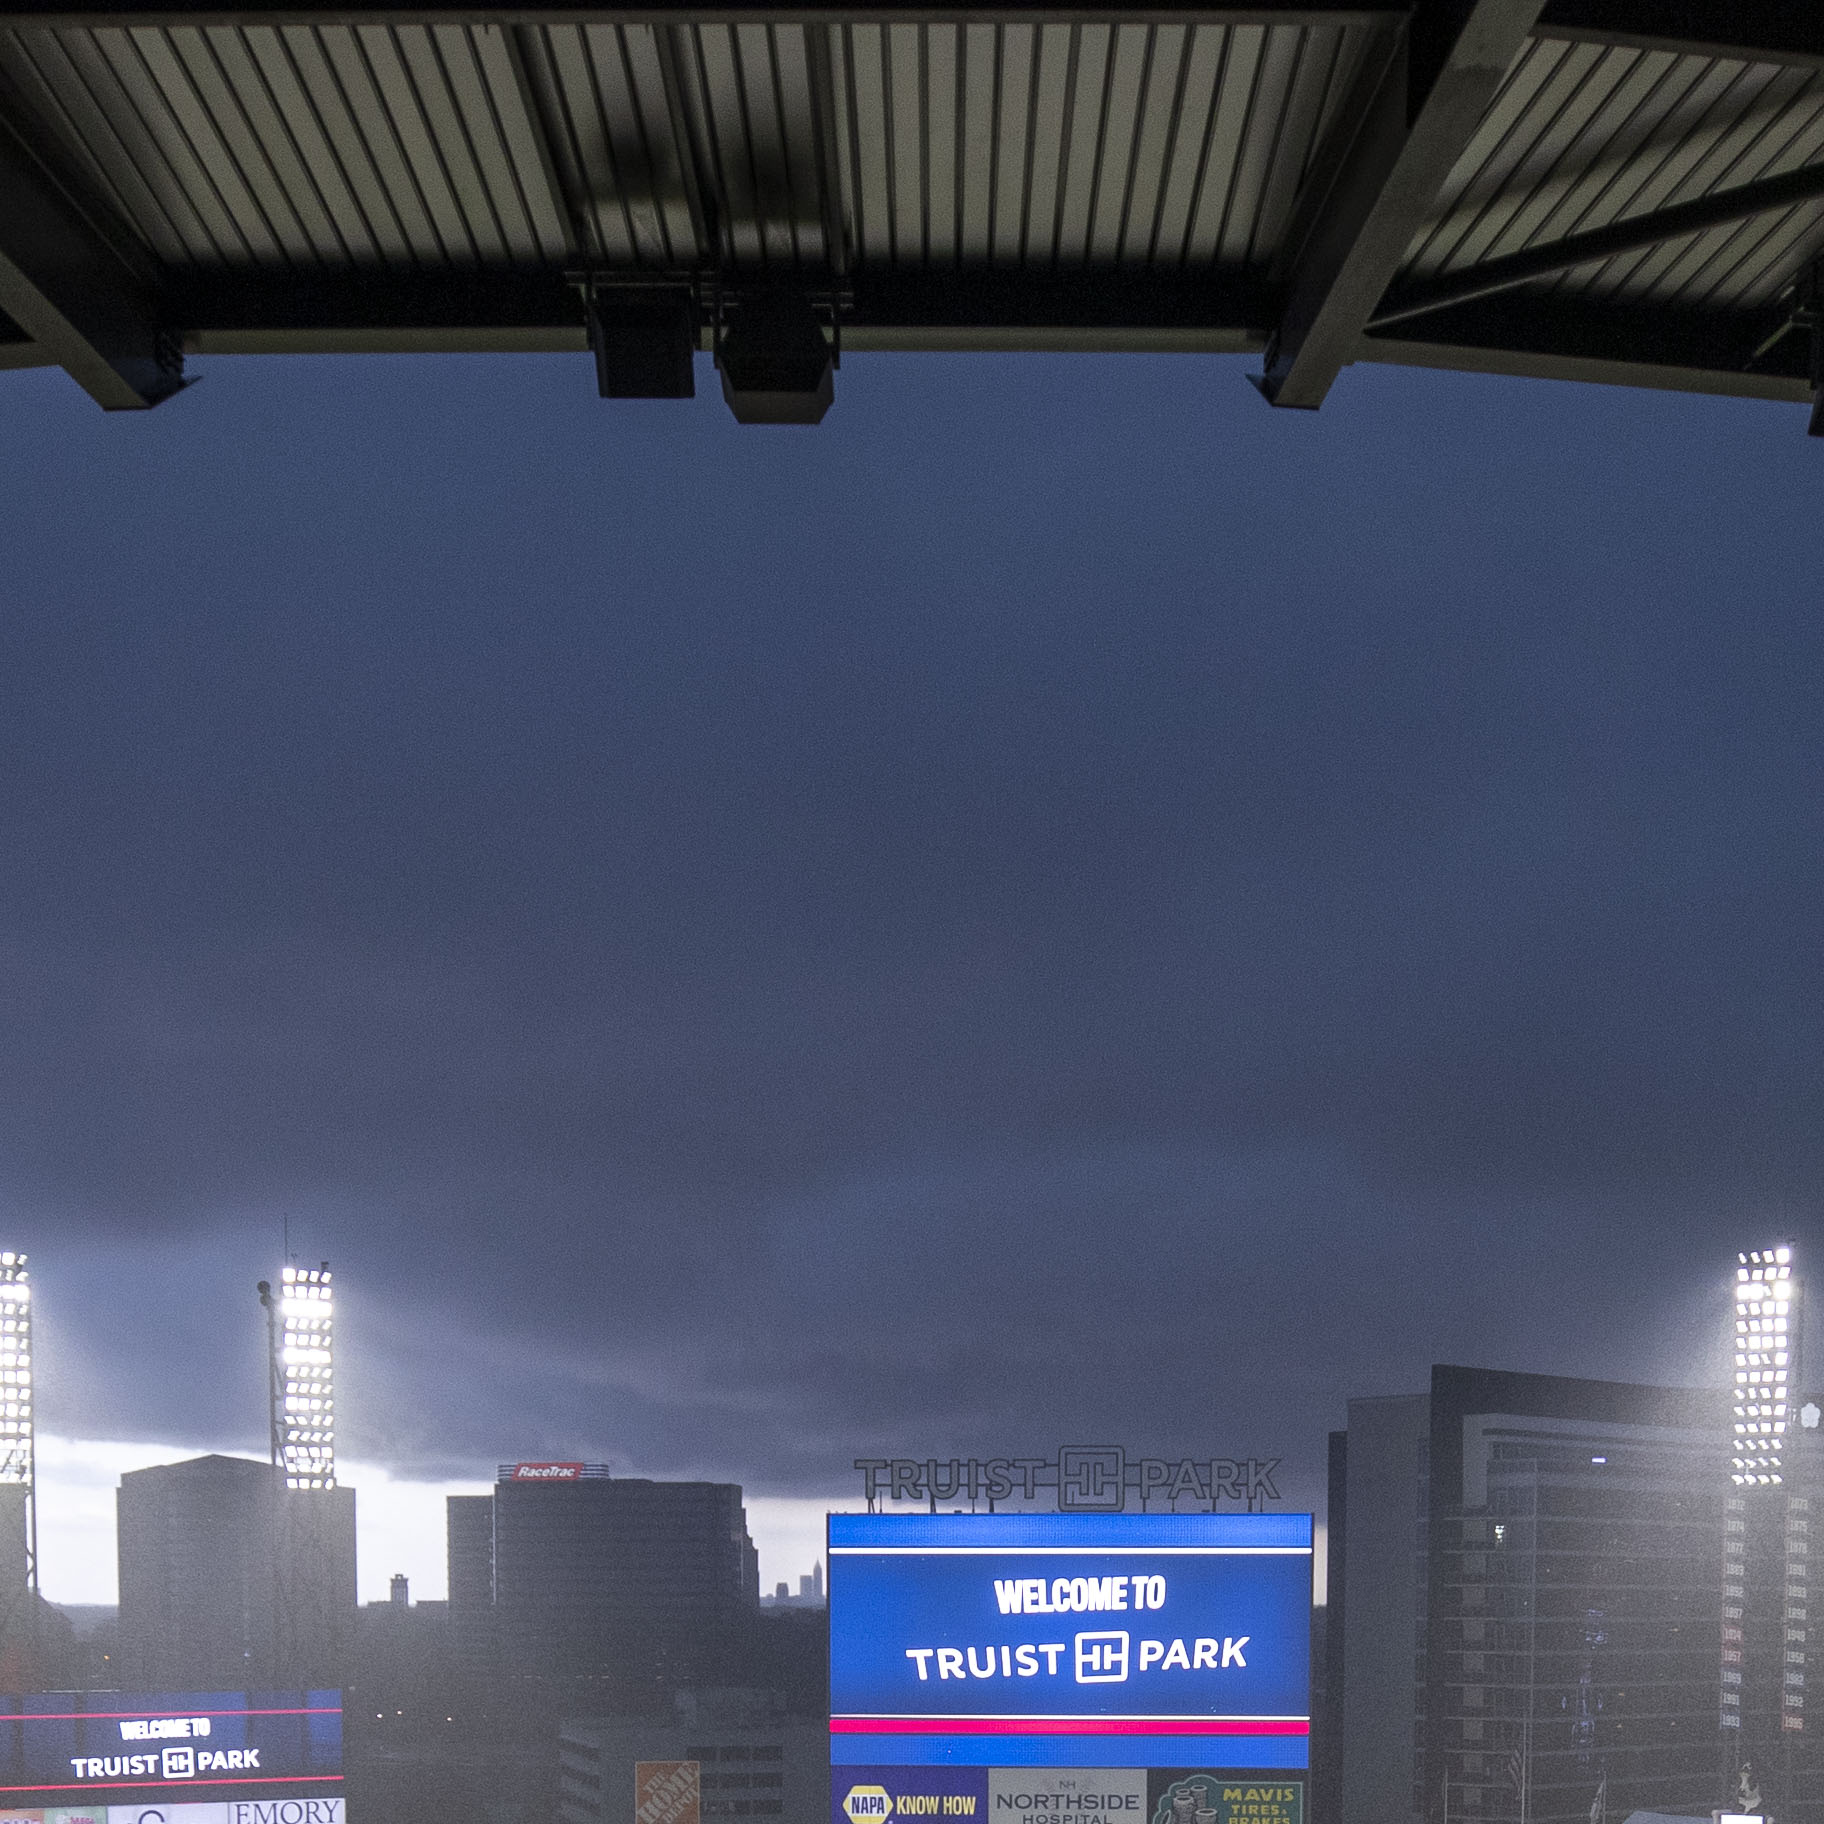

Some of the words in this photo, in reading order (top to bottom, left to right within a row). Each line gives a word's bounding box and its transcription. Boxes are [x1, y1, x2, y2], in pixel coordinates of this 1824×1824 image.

[518, 1466, 575, 1477] RaceTrac
[855, 1458, 1046, 1500] TRUIST
[1139, 1458, 1281, 1500] PARK
[993, 1576, 1128, 1614] WELCOME
[1131, 1574, 1167, 1610] TO
[905, 1643, 1066, 1681] TRUIST
[1138, 1636, 1251, 1672] PARK
[119, 1718, 190, 1741] WELCOME
[190, 1717, 211, 1737] TO
[70, 1754, 159, 1778] TRUIST
[197, 1748, 260, 1771] PARK
[996, 1794, 1140, 1811] NORTHSIDE
[1223, 1788, 1295, 1802] MAVIS
[850, 1796, 886, 1815] NAPA
[896, 1796, 939, 1816] KNOW
[943, 1796, 977, 1816] HOW
[1231, 1804, 1280, 1815] TIRES
